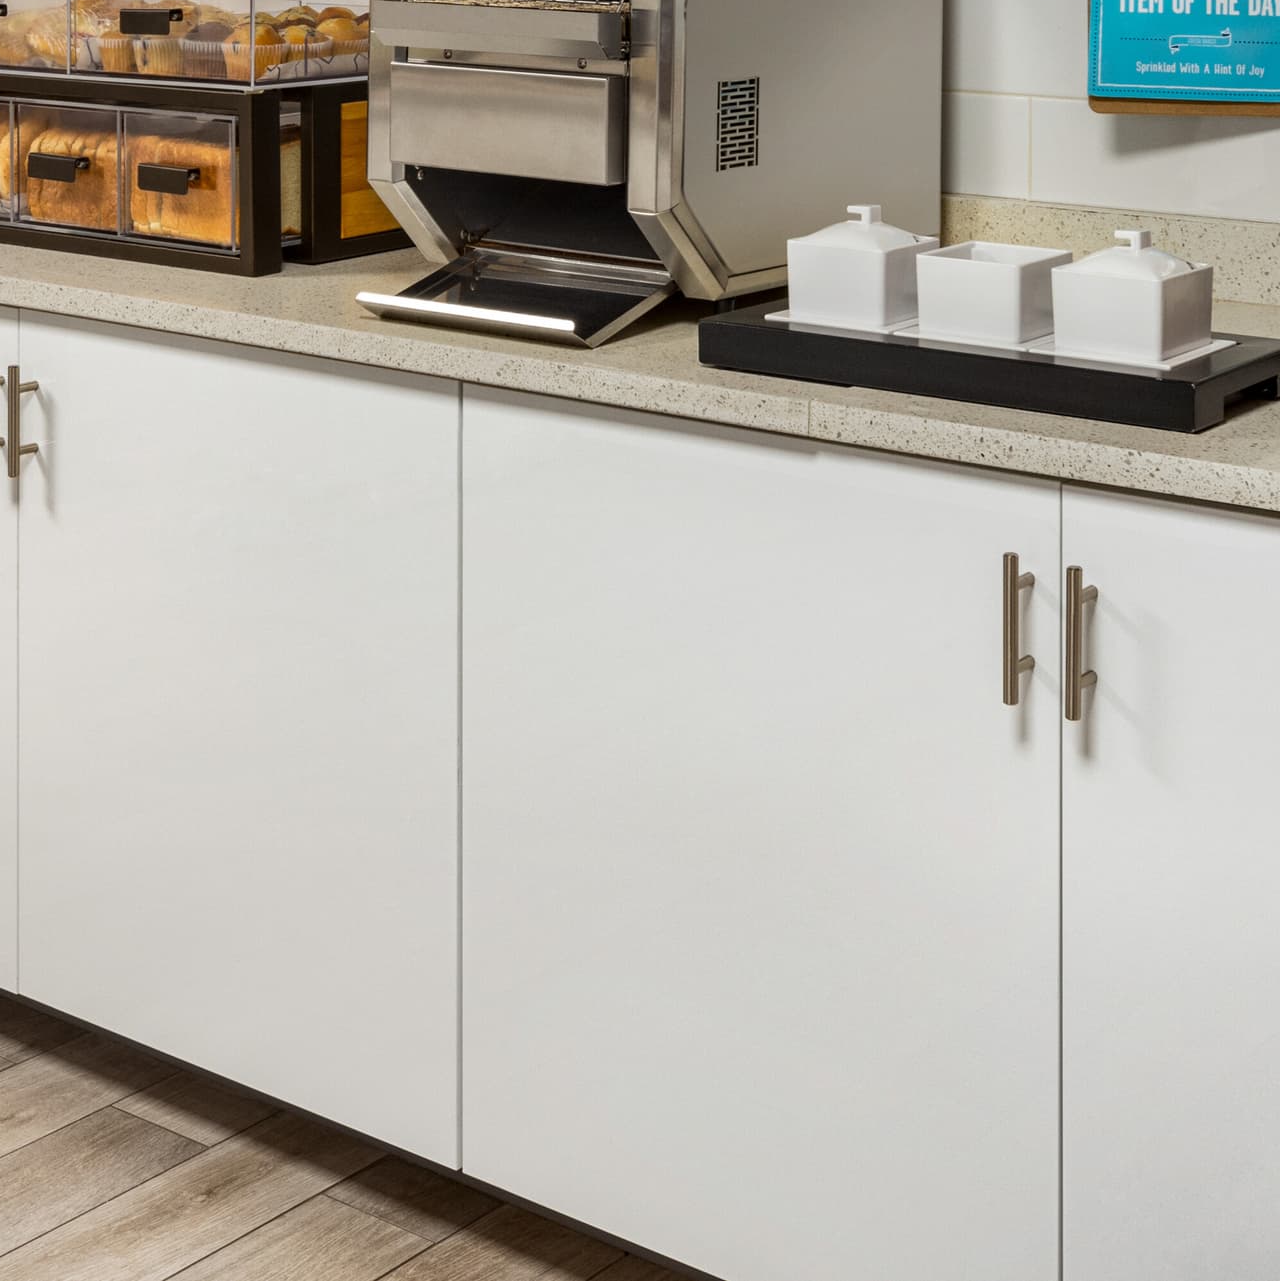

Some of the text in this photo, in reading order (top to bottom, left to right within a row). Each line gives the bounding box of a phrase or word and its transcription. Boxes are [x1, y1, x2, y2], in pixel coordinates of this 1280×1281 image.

[1135, 60, 1265, 78] Sprinkled With A Hint Of Joy
